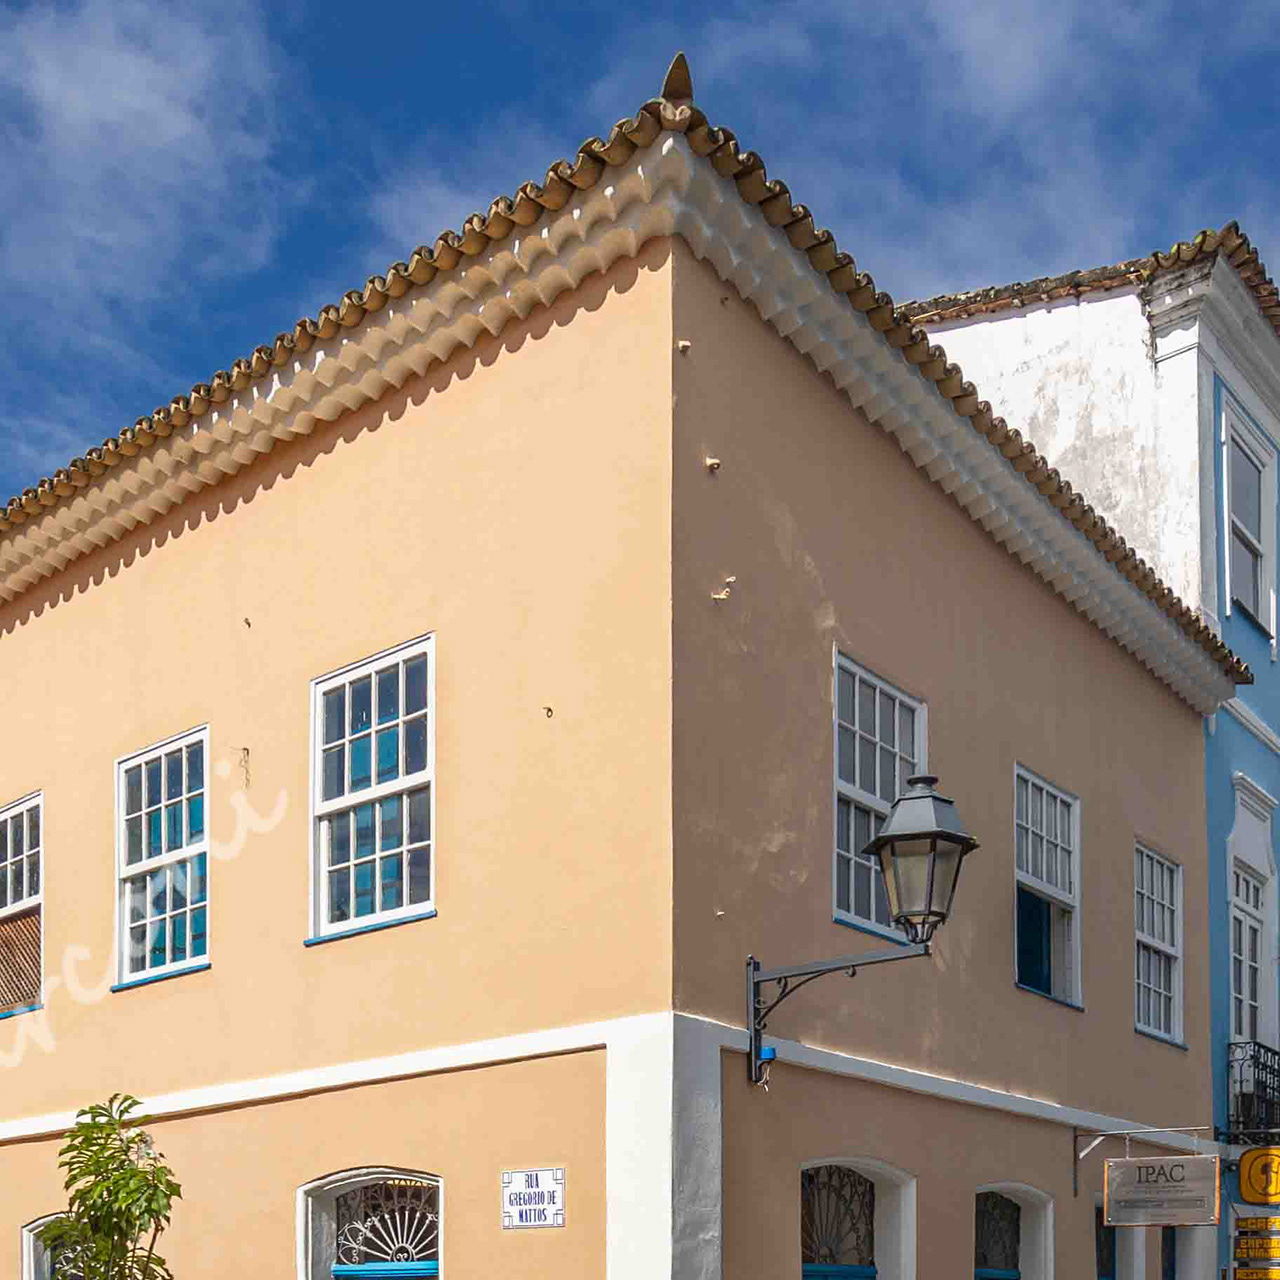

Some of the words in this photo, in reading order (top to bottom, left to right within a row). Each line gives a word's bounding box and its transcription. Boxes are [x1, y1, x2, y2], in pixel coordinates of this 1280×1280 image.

[525, 1173, 539, 1189] RUA
[1136, 1164, 1185, 1183] IPAC
[547, 1190, 557, 1205] DE
[518, 1208, 547, 1223] MATTOS
